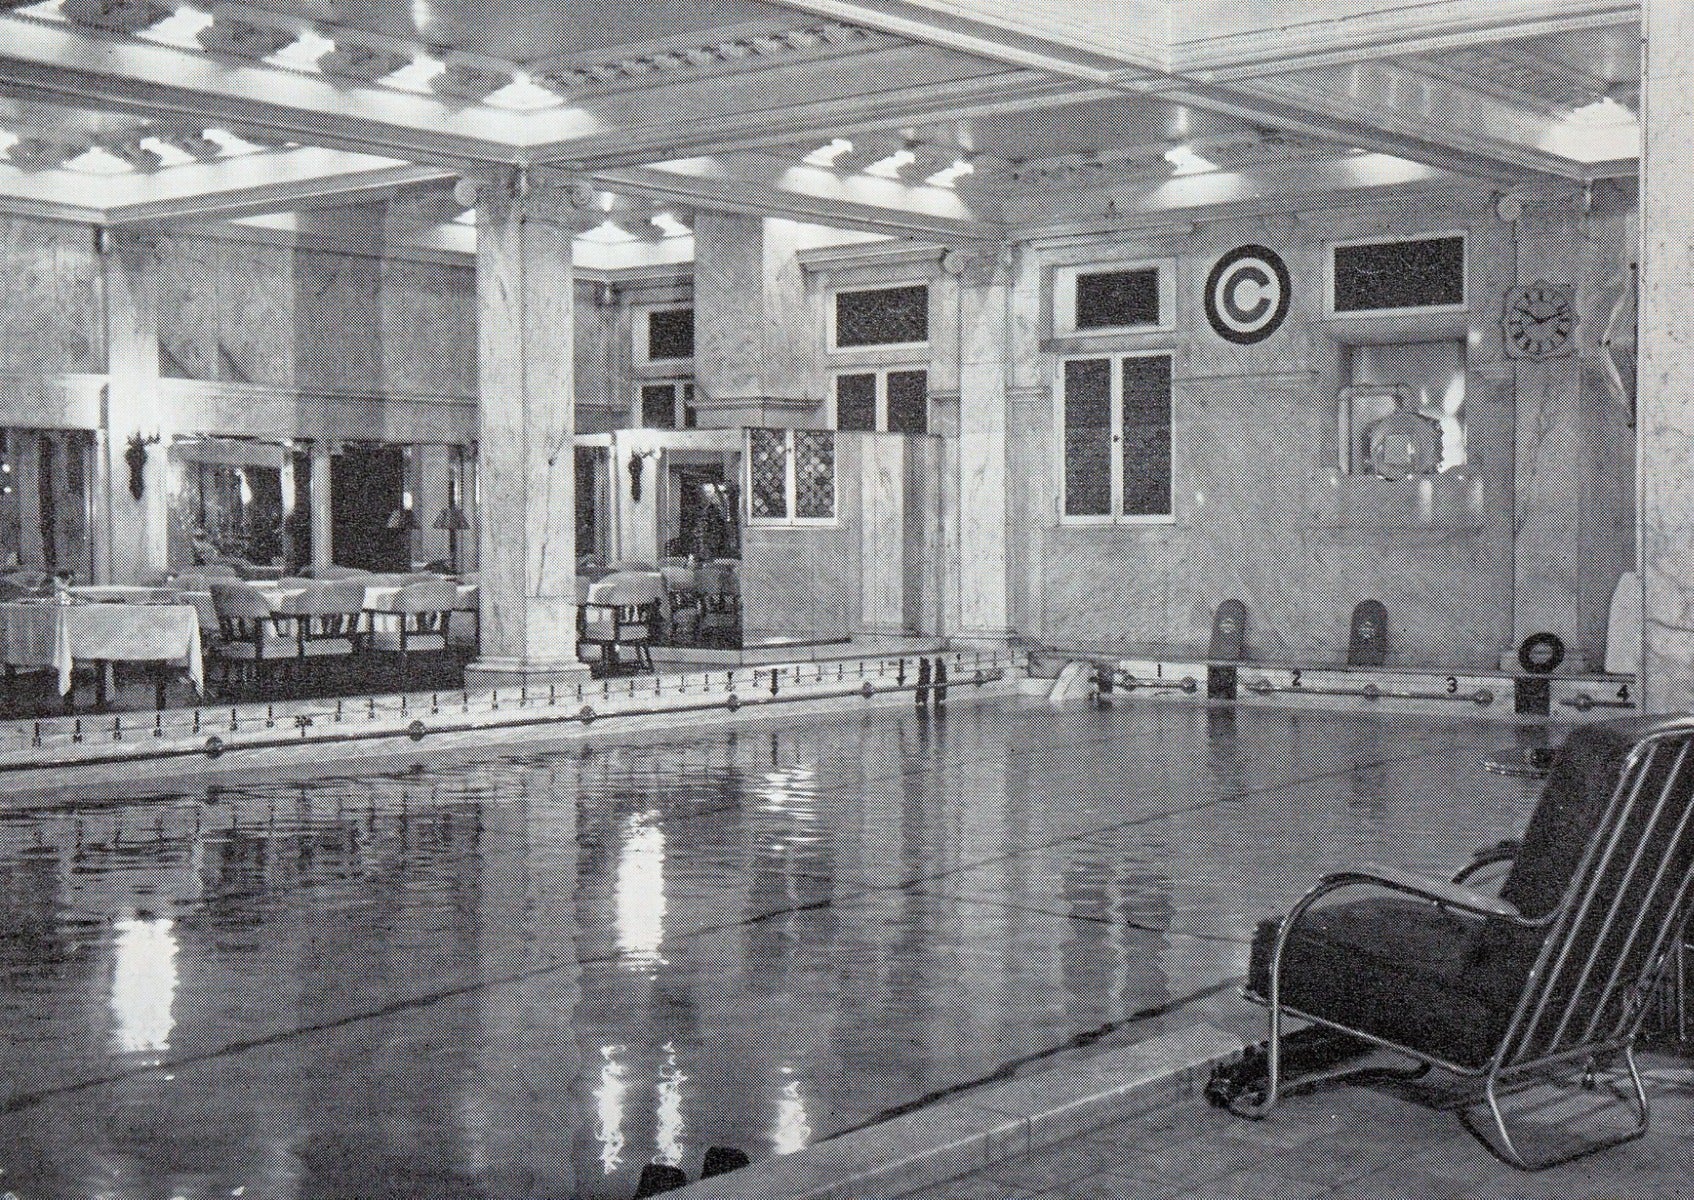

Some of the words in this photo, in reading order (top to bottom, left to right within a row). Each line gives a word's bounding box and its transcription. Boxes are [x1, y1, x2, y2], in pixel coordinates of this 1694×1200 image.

[1223, 266, 1271, 324] C
[1292, 671, 1303, 687] 2
[1446, 676, 1458, 693] 3
[1616, 683, 1629, 702] 4
